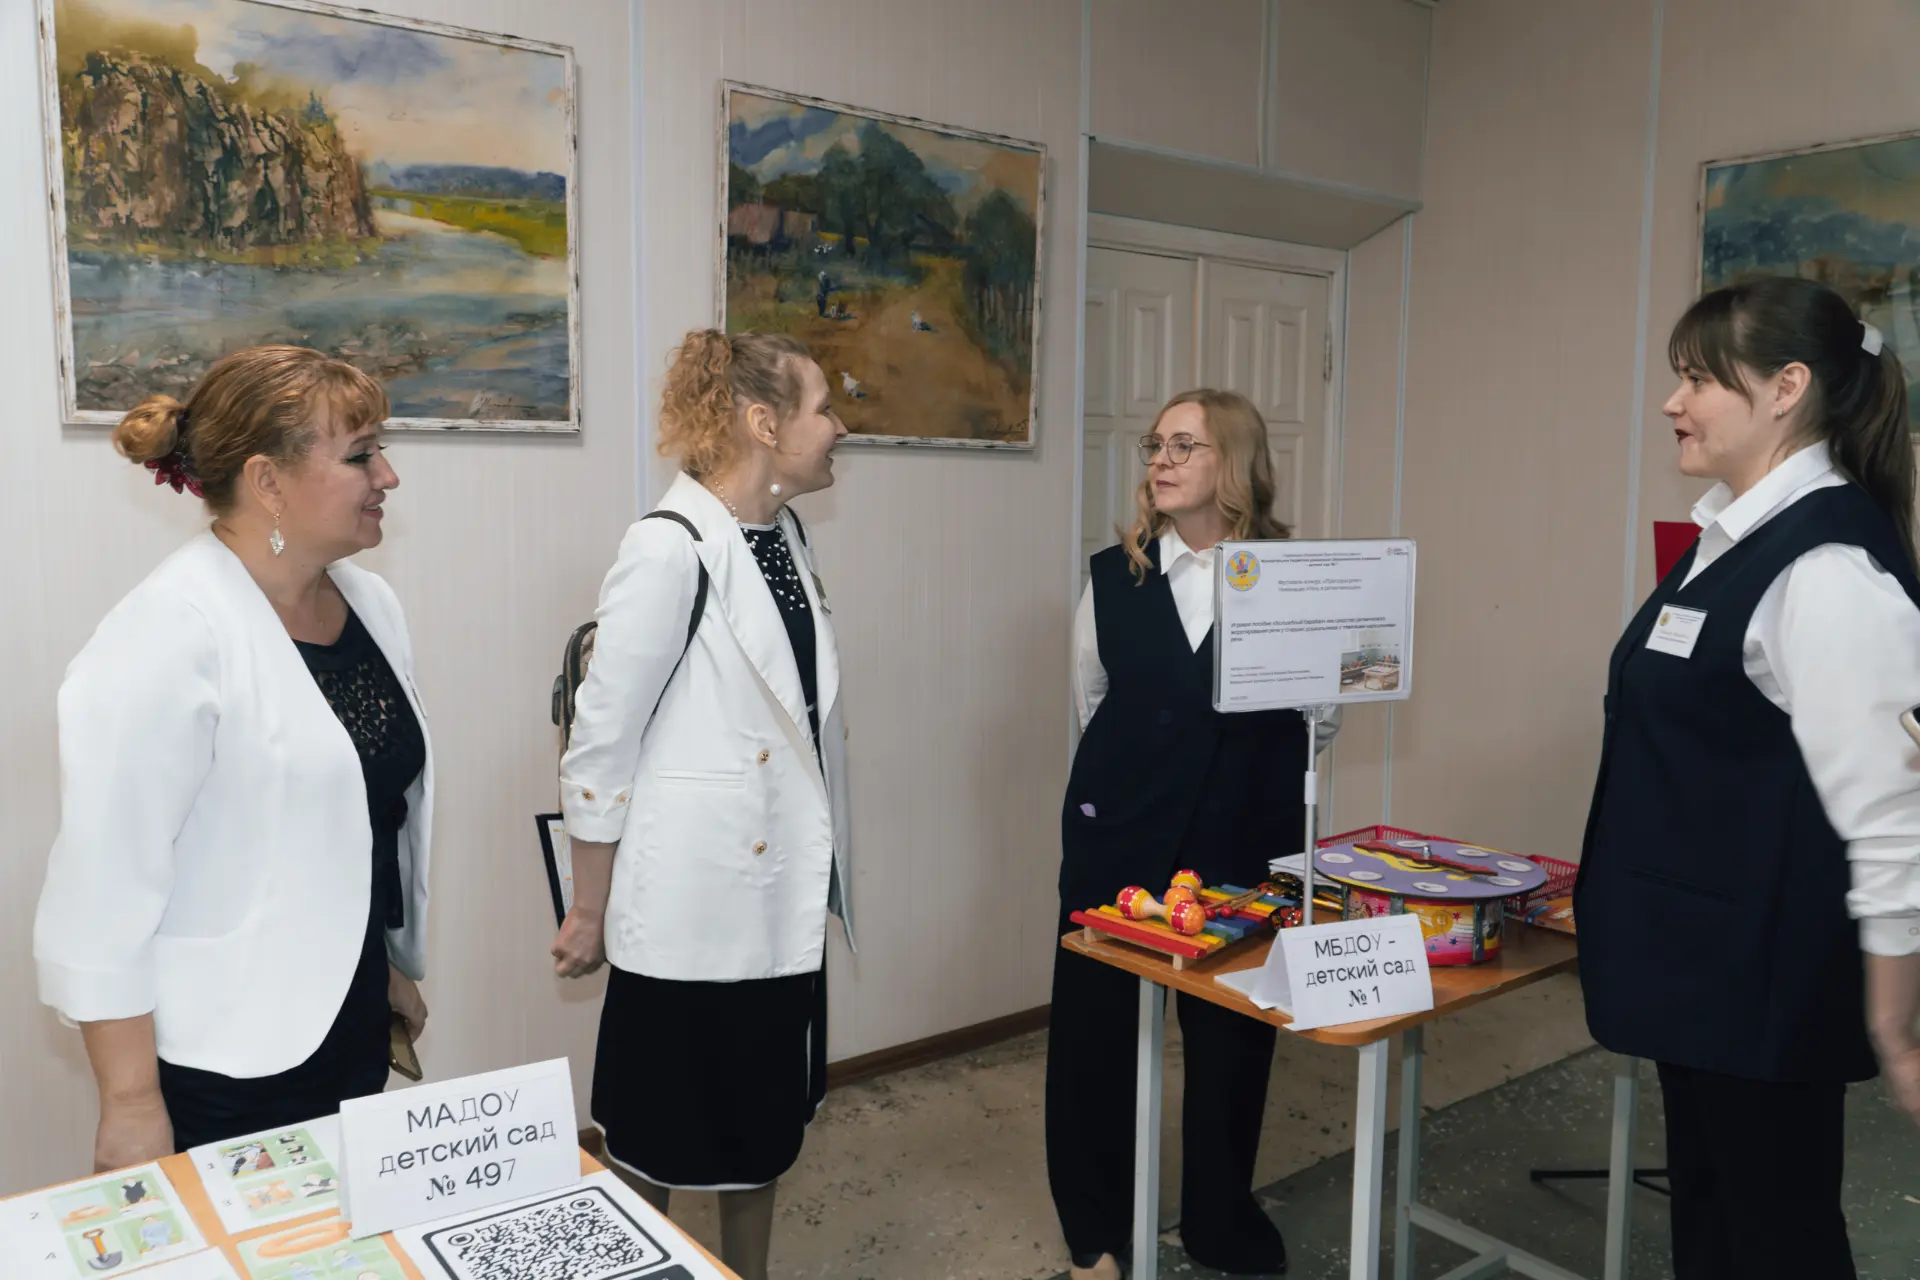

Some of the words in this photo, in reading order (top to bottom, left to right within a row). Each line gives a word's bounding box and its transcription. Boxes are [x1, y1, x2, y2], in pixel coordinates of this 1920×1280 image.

[1314, 933, 1381, 958] МБДОУ
[1306, 958, 1379, 988] детский
[1383, 959, 1416, 976] сад
[1348, 989, 1368, 1008] №
[1372, 985, 1381, 1004] 1
[406, 1089, 520, 1133] МАДОУ
[379, 1126, 499, 1178] детский
[506, 1121, 557, 1146] сад
[426, 1174, 457, 1201] №
[465, 1158, 517, 1190] 497
